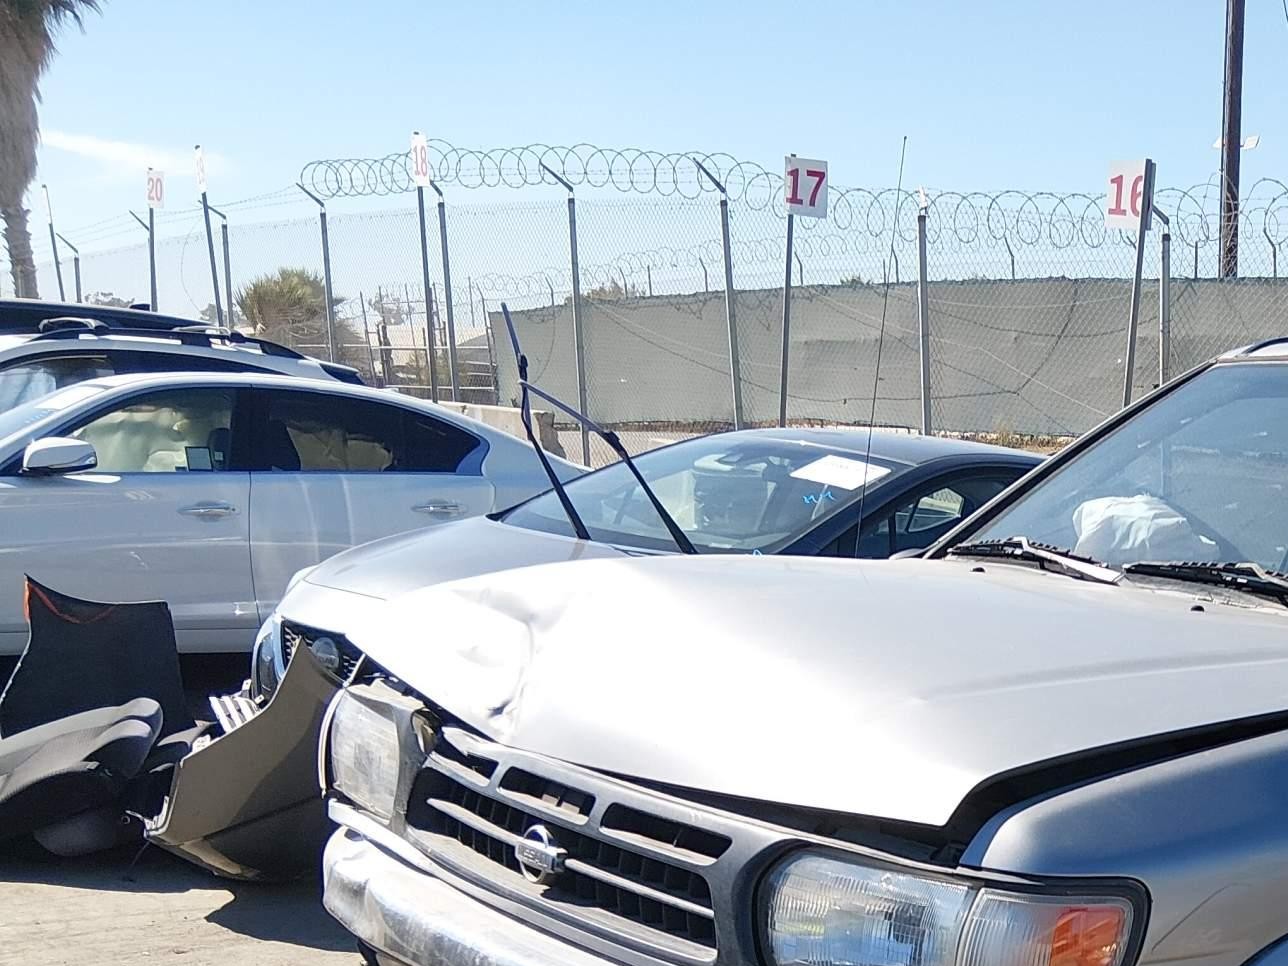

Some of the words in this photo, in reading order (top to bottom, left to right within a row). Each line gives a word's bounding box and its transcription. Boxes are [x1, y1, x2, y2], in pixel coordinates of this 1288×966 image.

[413, 145, 428, 177] 18
[147, 177, 163, 202] 20
[786, 168, 826, 208] 17
